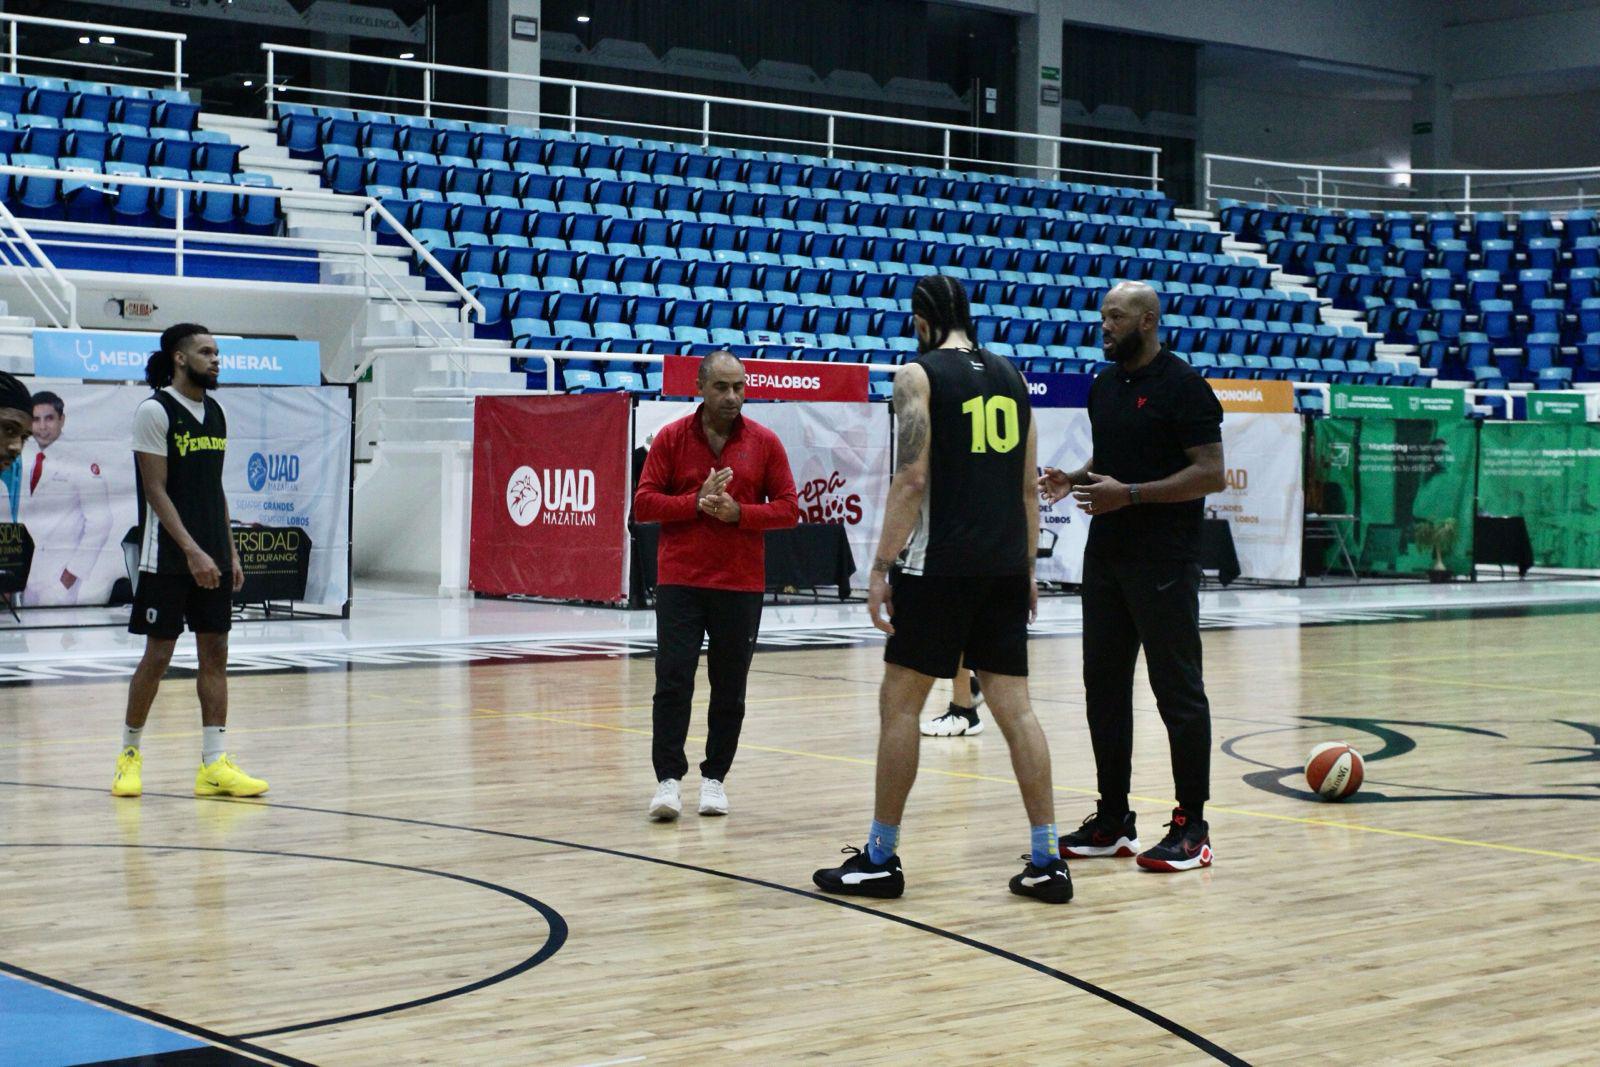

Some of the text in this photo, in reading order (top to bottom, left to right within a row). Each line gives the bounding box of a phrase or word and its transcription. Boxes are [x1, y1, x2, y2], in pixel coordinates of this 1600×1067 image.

[745, 374, 820, 389] REPALOBOS
[962, 395, 1020, 453] 10
[268, 454, 300, 482] UAD
[1226, 468, 1248, 489] AD
[543, 468, 596, 512] UAD
[263, 501, 295, 512] GRANDES
[287, 516, 310, 526] LOBOS
[1044, 516, 1072, 524] LOBOS
[232, 531, 300, 552] ERSIDAD
